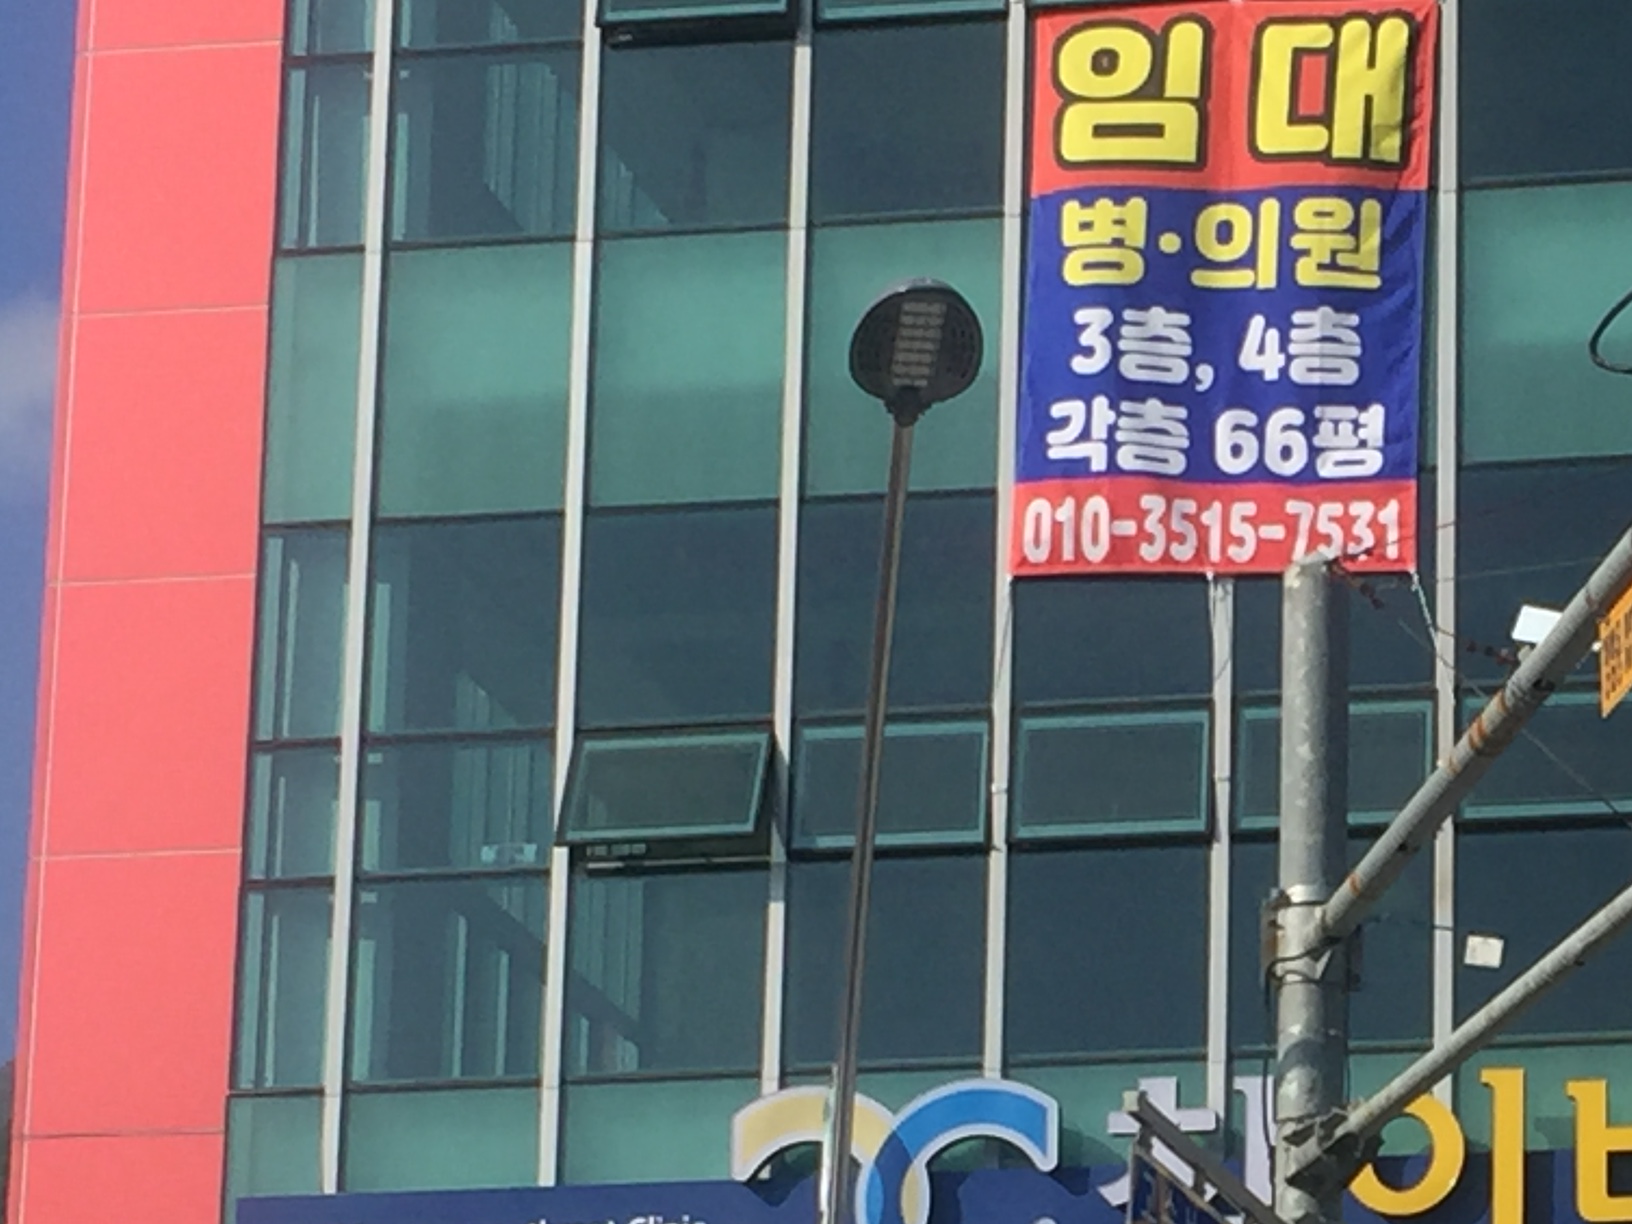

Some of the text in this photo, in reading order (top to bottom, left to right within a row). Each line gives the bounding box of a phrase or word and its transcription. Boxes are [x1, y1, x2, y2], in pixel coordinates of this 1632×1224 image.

[1060, 196, 1382, 290] 병·의원
[1069, 305, 1363, 392] 3층, 4층
[1046, 394, 1386, 478] 각층 66평
[1022, 494, 1401, 563] 010-3515-7531
